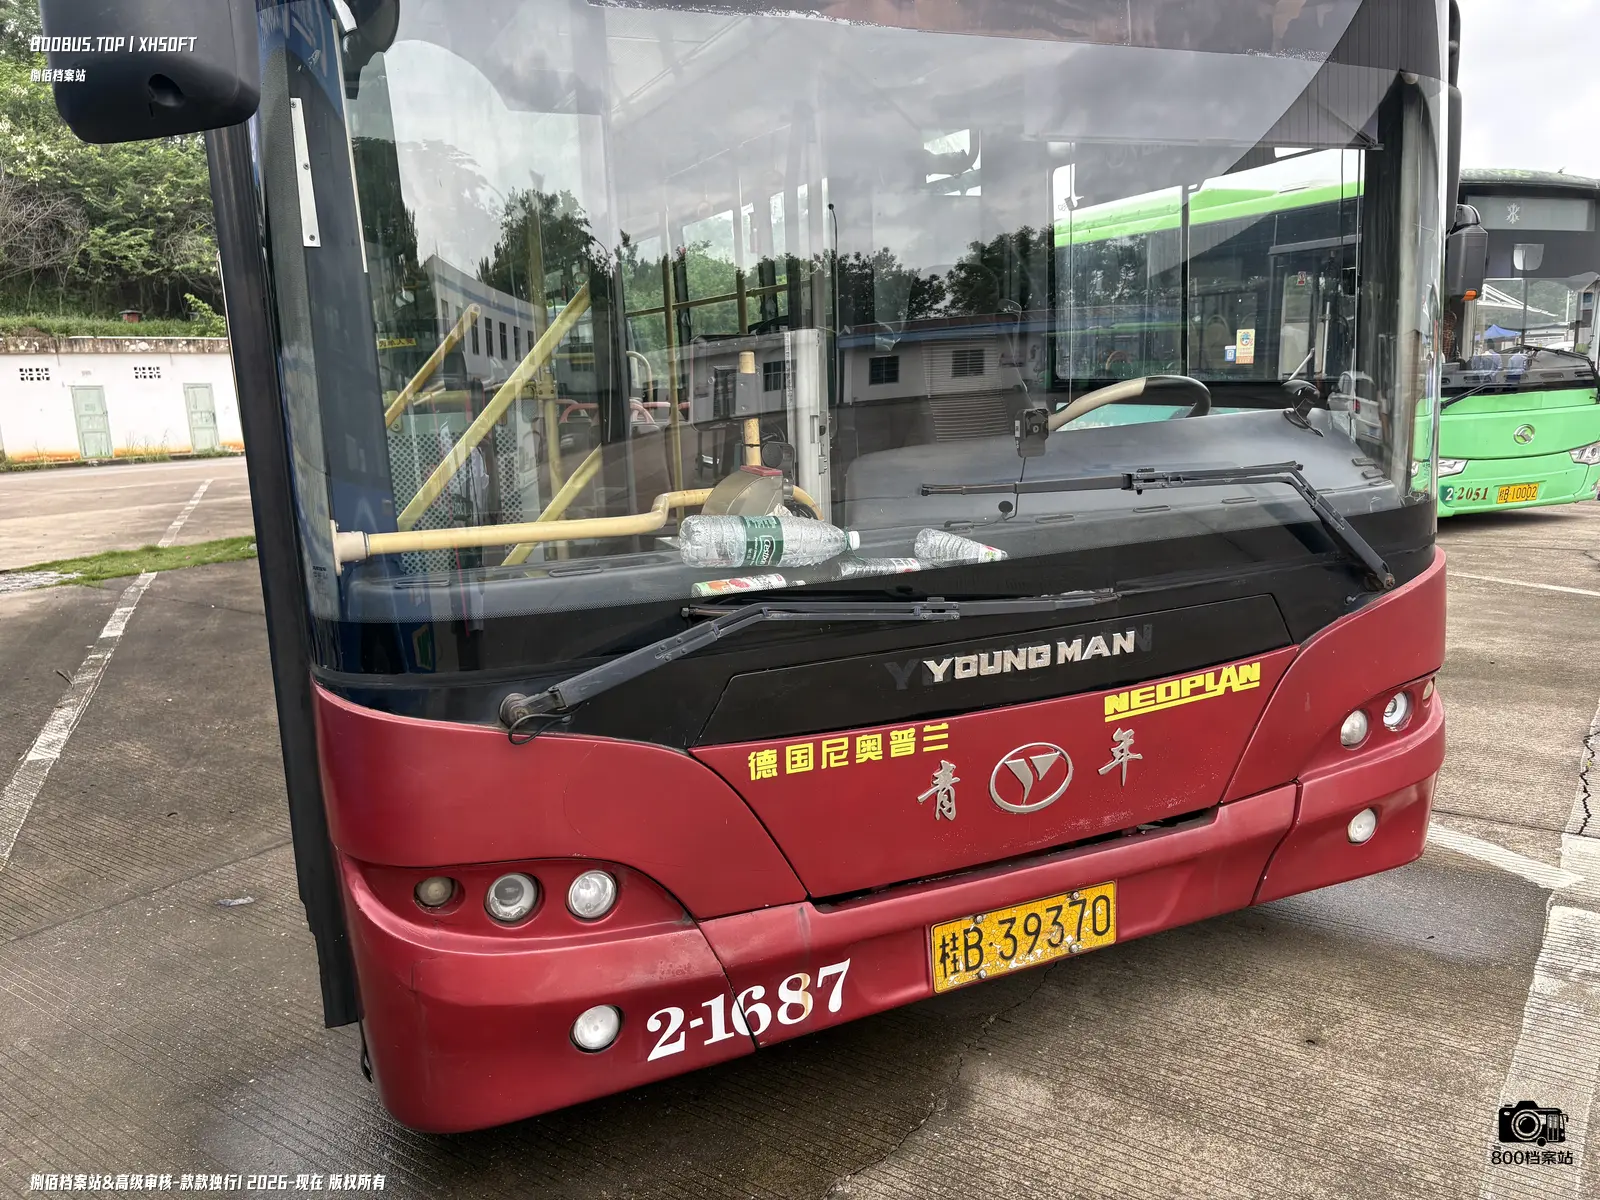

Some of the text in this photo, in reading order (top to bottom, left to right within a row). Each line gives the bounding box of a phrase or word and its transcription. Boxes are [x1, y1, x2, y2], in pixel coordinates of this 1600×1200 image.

[1445, 486, 1490, 501] 2-2051
[922, 630, 1136, 683] YOUNG MAN
[1104, 661, 1261, 719] NEOPLAN
[747, 721, 950, 781] 德国尼奥普兰
[646, 957, 852, 1062] 2-1687
